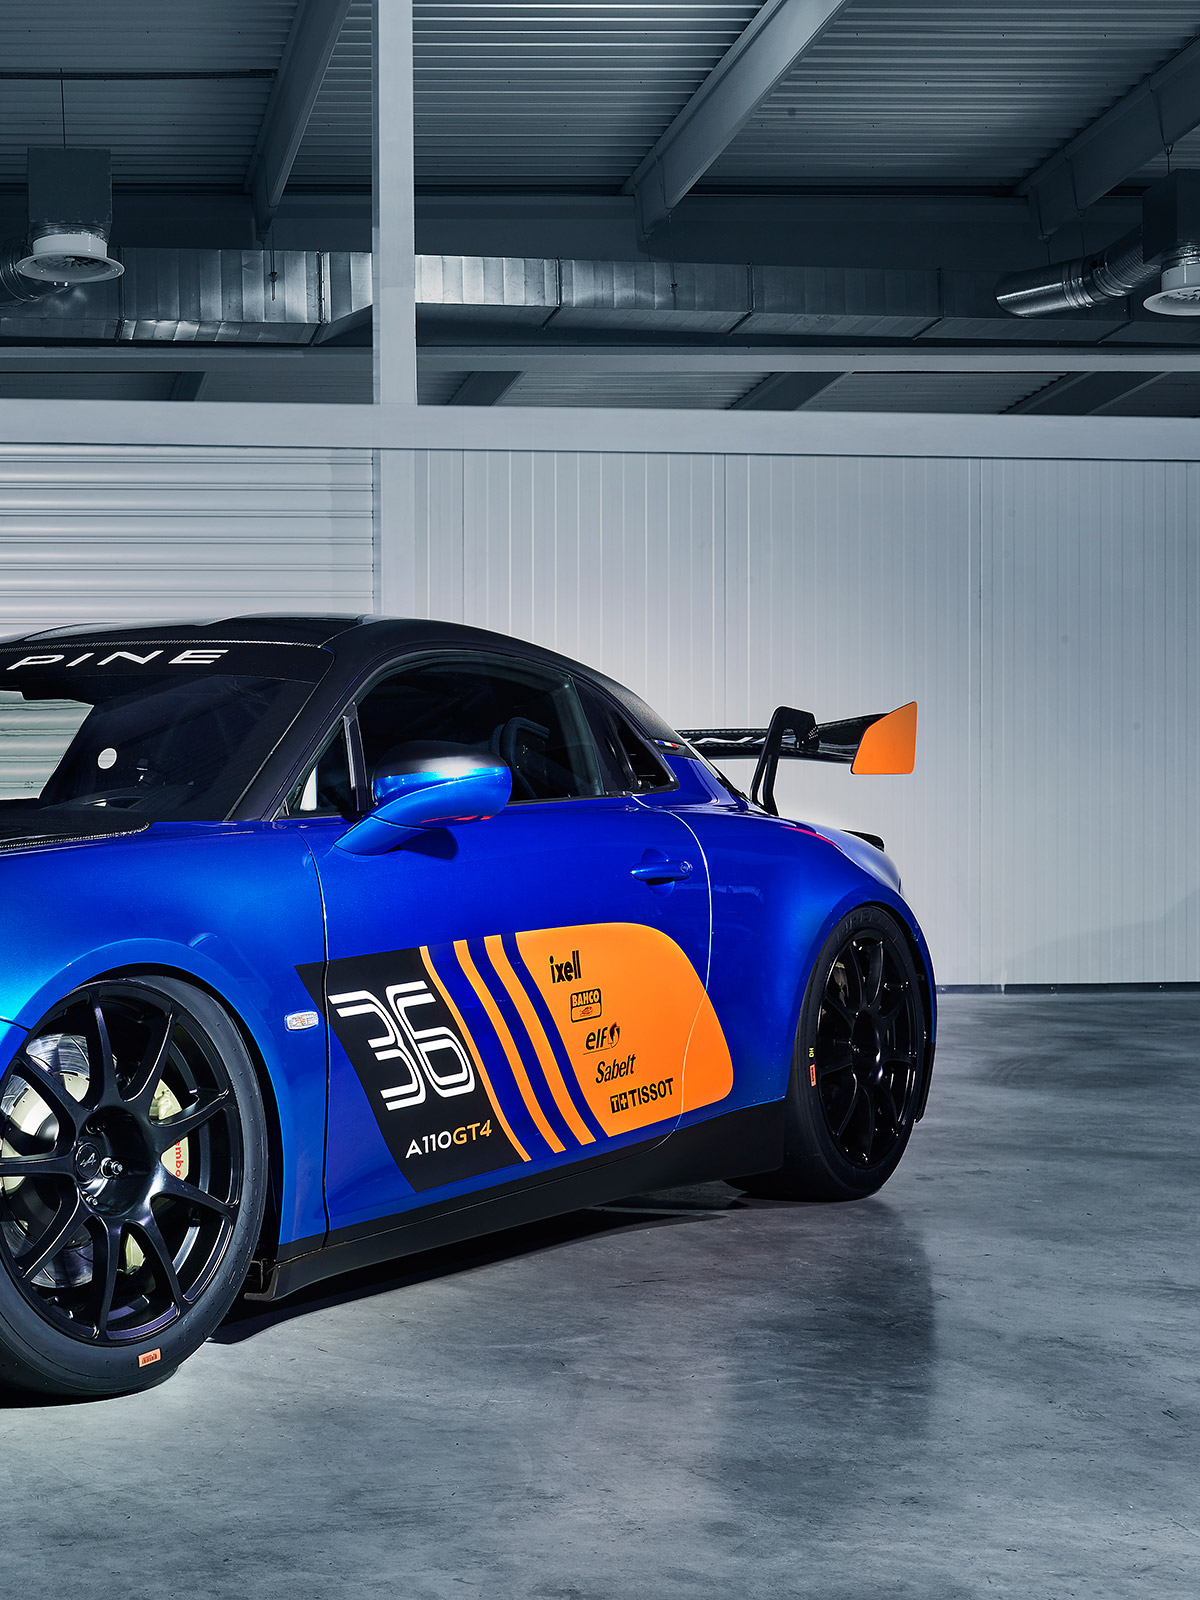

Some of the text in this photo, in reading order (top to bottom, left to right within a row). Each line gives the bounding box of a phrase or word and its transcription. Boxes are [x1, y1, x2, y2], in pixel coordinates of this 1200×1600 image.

[549, 950, 582, 984] ixell
[571, 989, 600, 1008] BAHCO
[327, 980, 476, 1111] 36
[585, 1026, 609, 1051] elf
[595, 1054, 636, 1084] Sabelt
[628, 1077, 674, 1108] TISSOT
[405, 1119, 492, 1159] A110GT4
